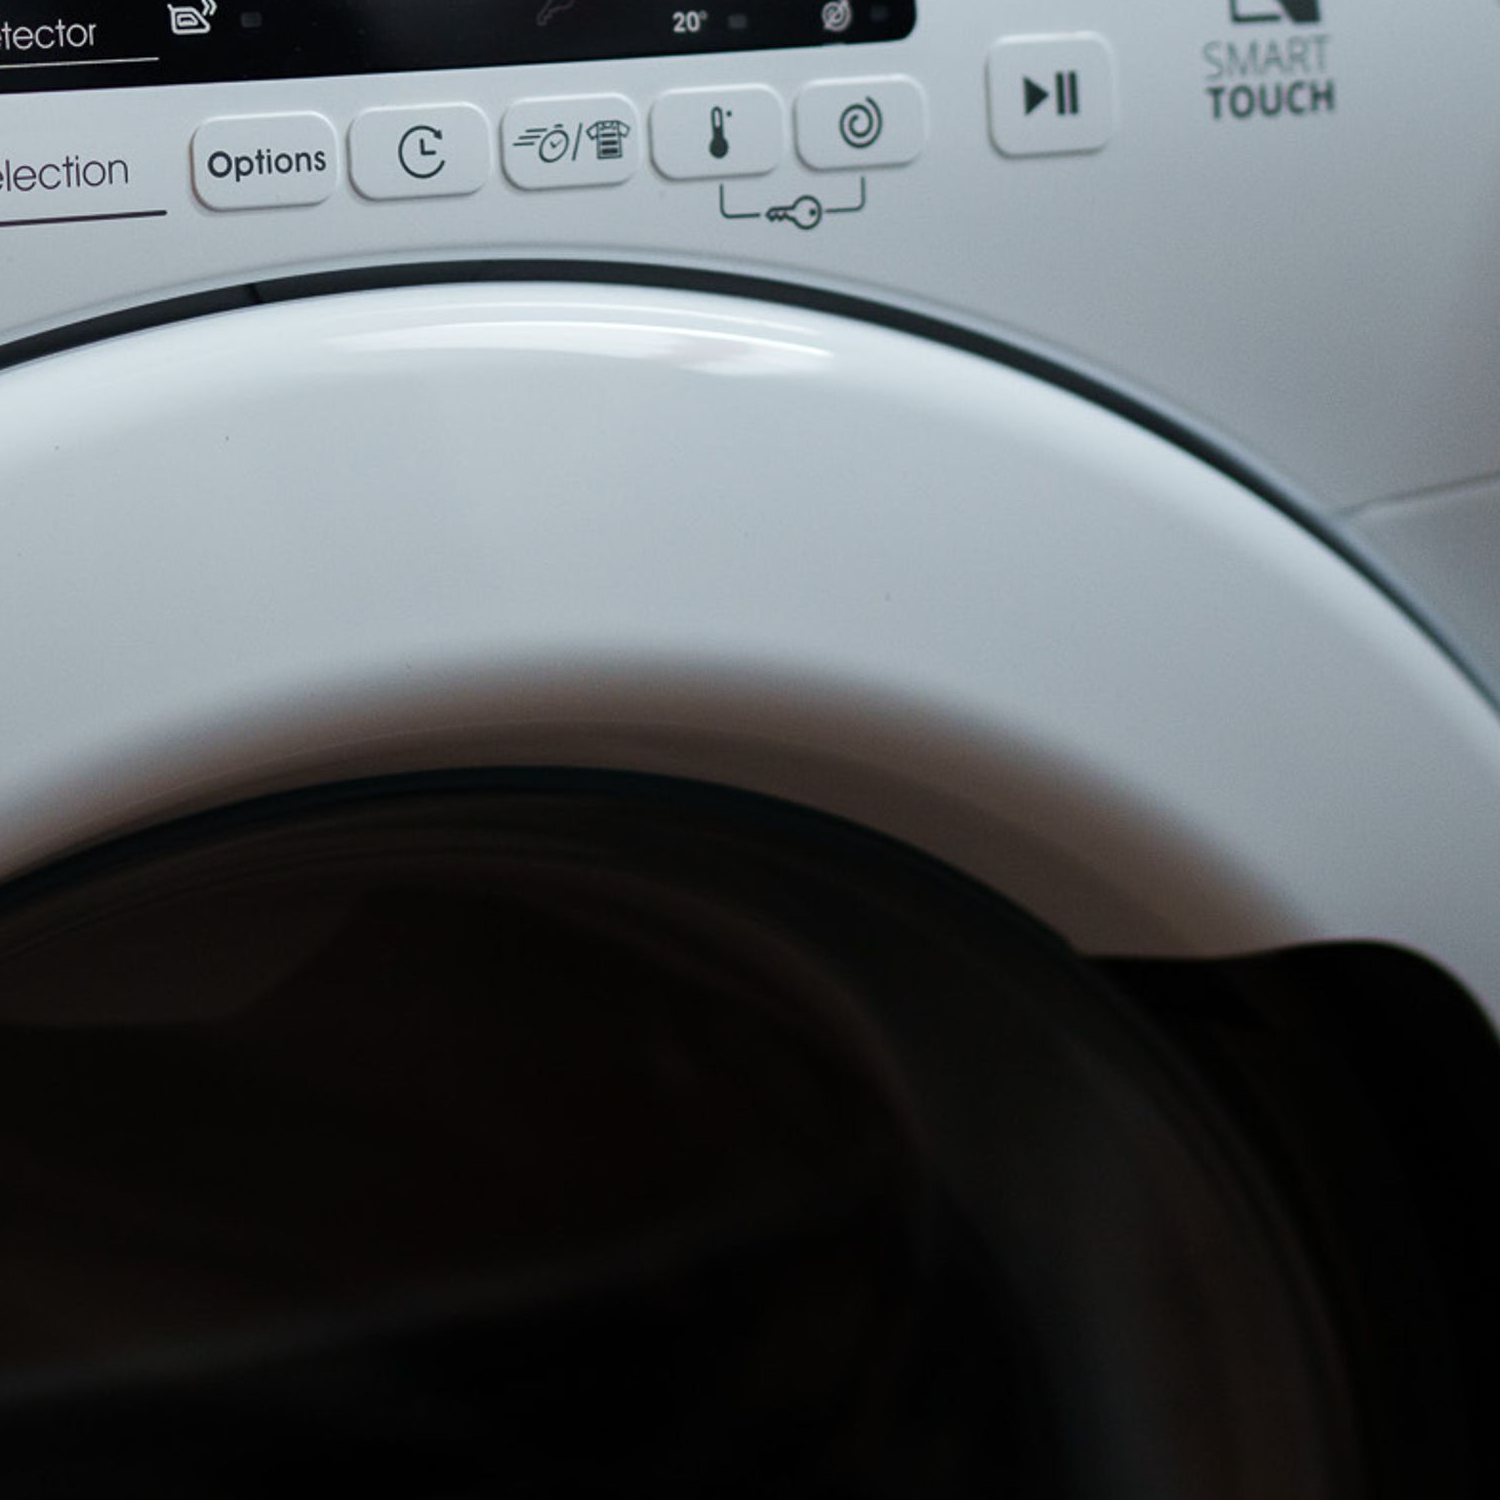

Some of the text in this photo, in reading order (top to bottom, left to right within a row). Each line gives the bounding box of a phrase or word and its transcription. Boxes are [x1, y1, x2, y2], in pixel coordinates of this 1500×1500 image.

[1203, 35, 1330, 79] SMART
[1205, 79, 1335, 122] TOUCH
[207, 147, 327, 183] Options
